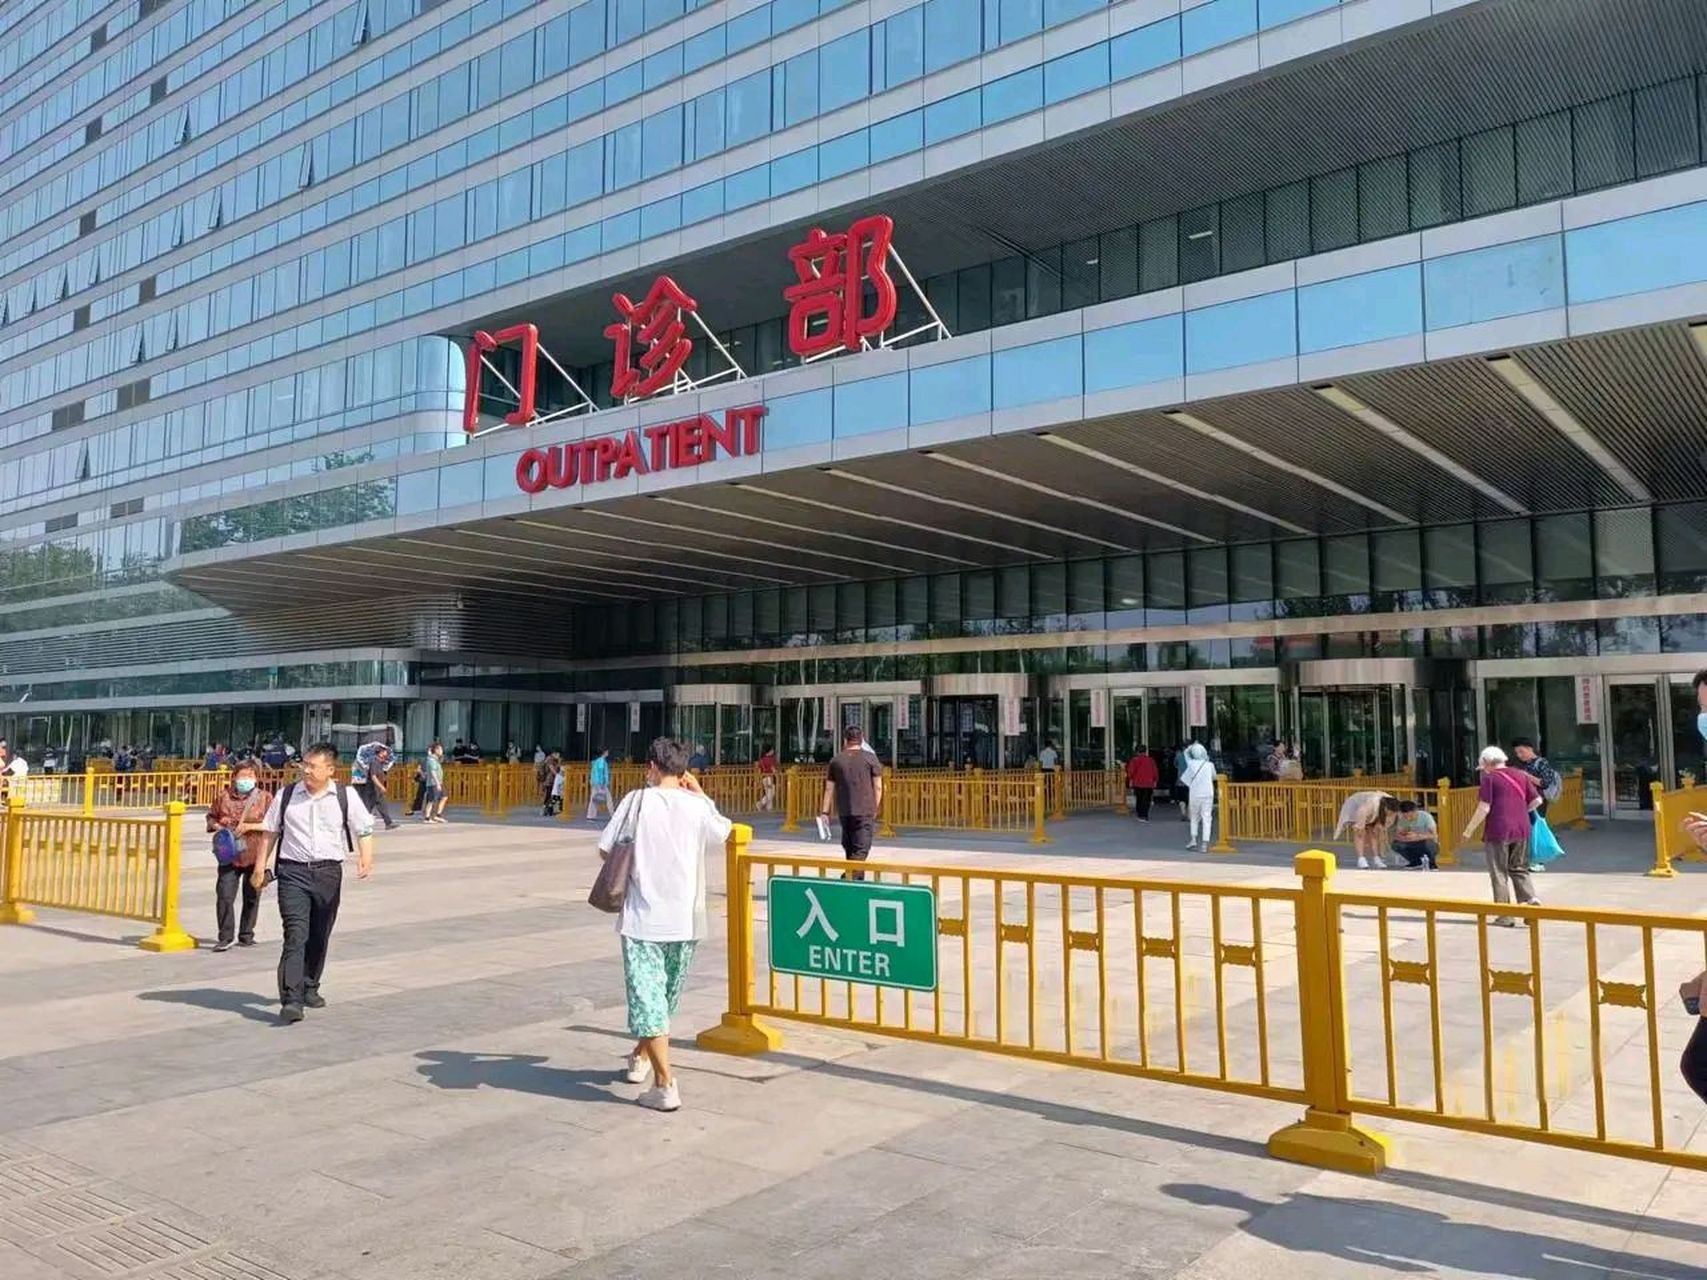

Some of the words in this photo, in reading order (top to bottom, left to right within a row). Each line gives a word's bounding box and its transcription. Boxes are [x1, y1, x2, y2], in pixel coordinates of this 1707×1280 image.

[463, 214, 896, 433] 门诊部
[516, 405, 769, 494] OUTPATIENT
[796, 887, 905, 948] 入口
[809, 944, 891, 977] ENTER
